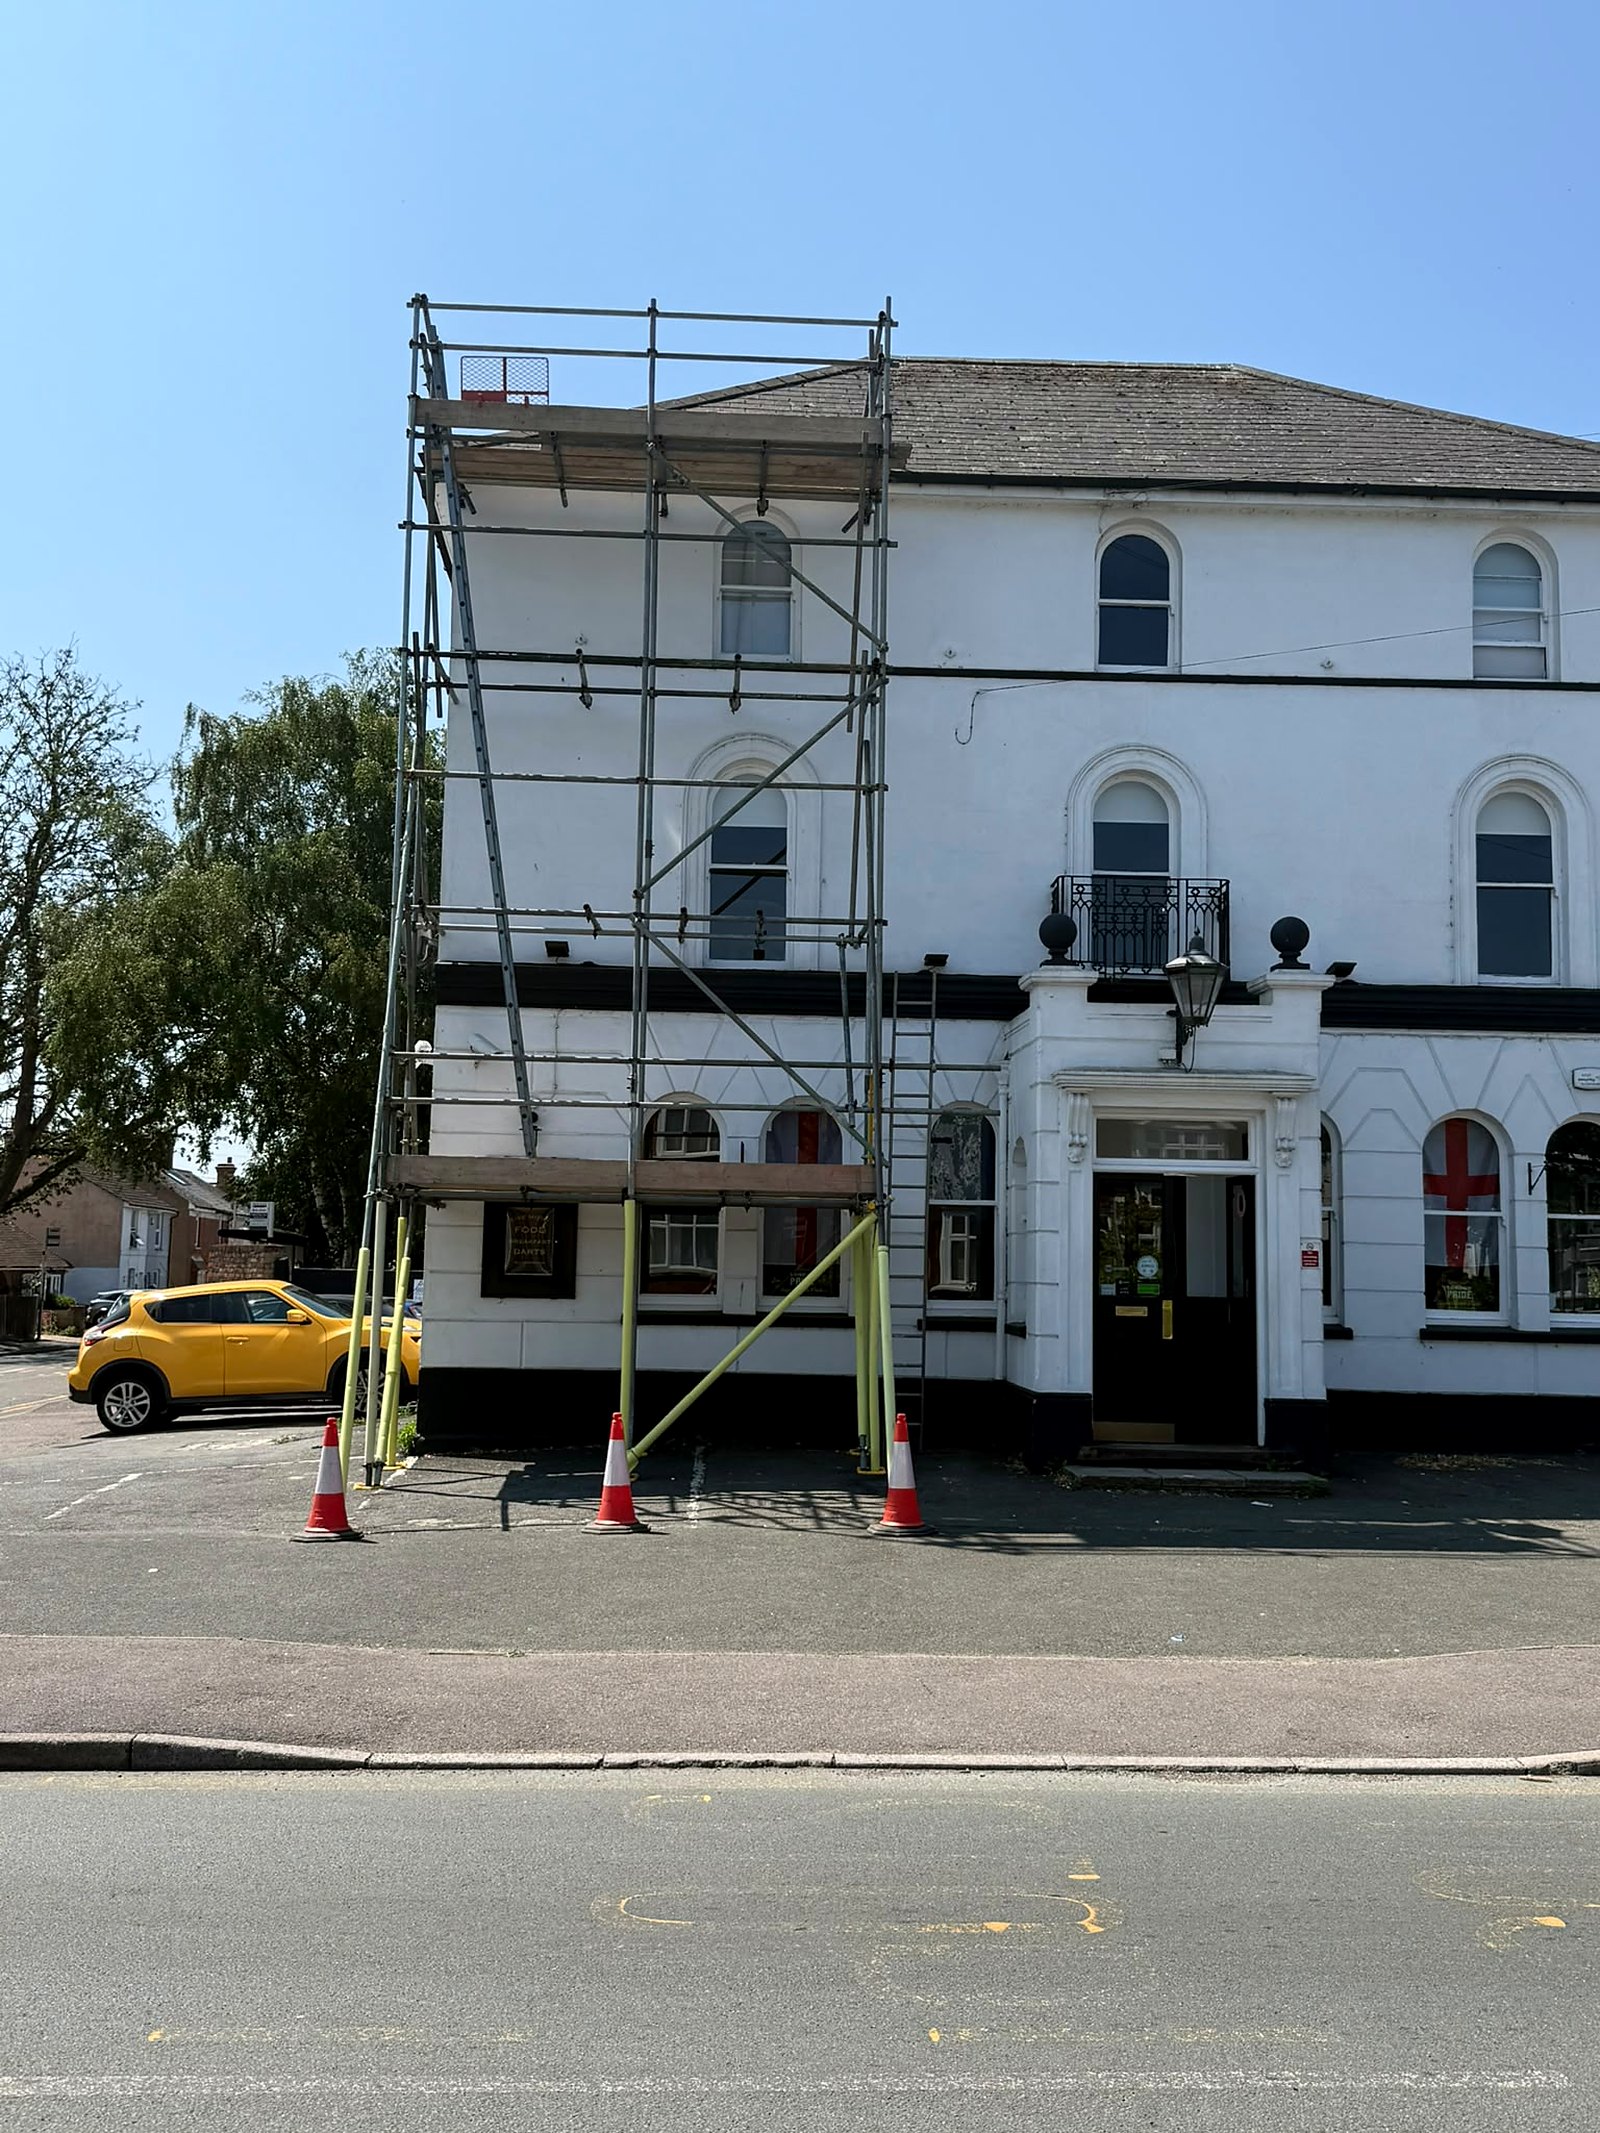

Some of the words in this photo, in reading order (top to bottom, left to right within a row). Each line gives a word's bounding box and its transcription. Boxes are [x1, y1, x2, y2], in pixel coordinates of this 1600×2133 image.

[514, 1225, 546, 1234] FOOD
[513, 1248, 545, 1256] DARTS
[1447, 1290, 1473, 1300] PRIDE
